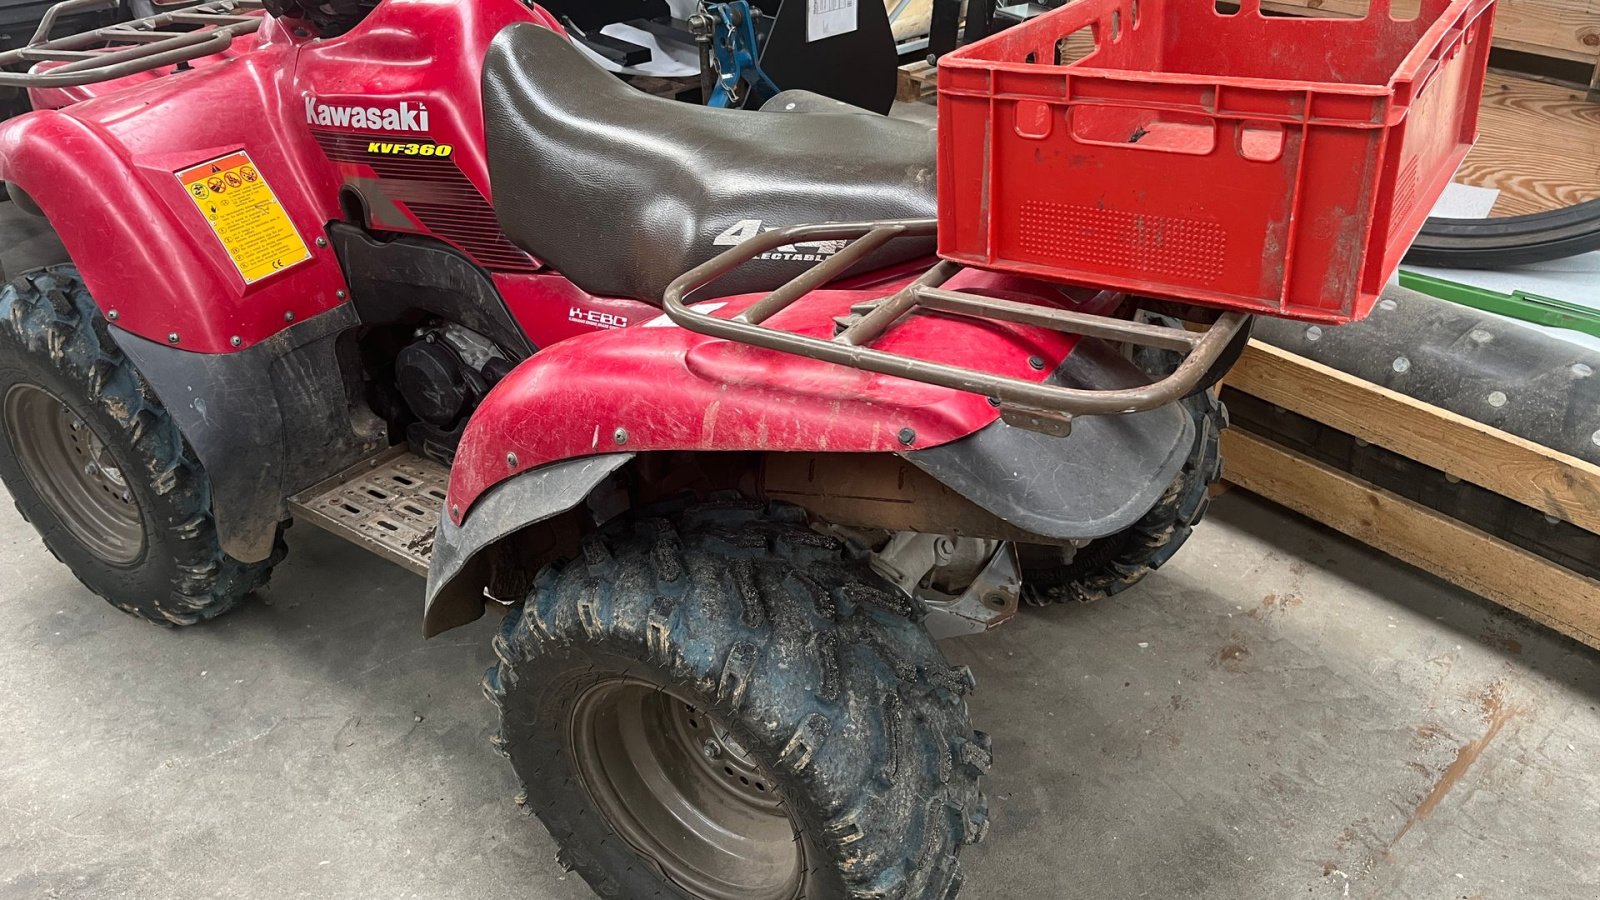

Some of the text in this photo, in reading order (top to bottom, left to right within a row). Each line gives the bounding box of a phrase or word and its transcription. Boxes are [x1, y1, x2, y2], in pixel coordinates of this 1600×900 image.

[304, 97, 429, 132] Kawasaki
[367, 142, 452, 157] KVF360
[568, 307, 628, 328] K-EBC
